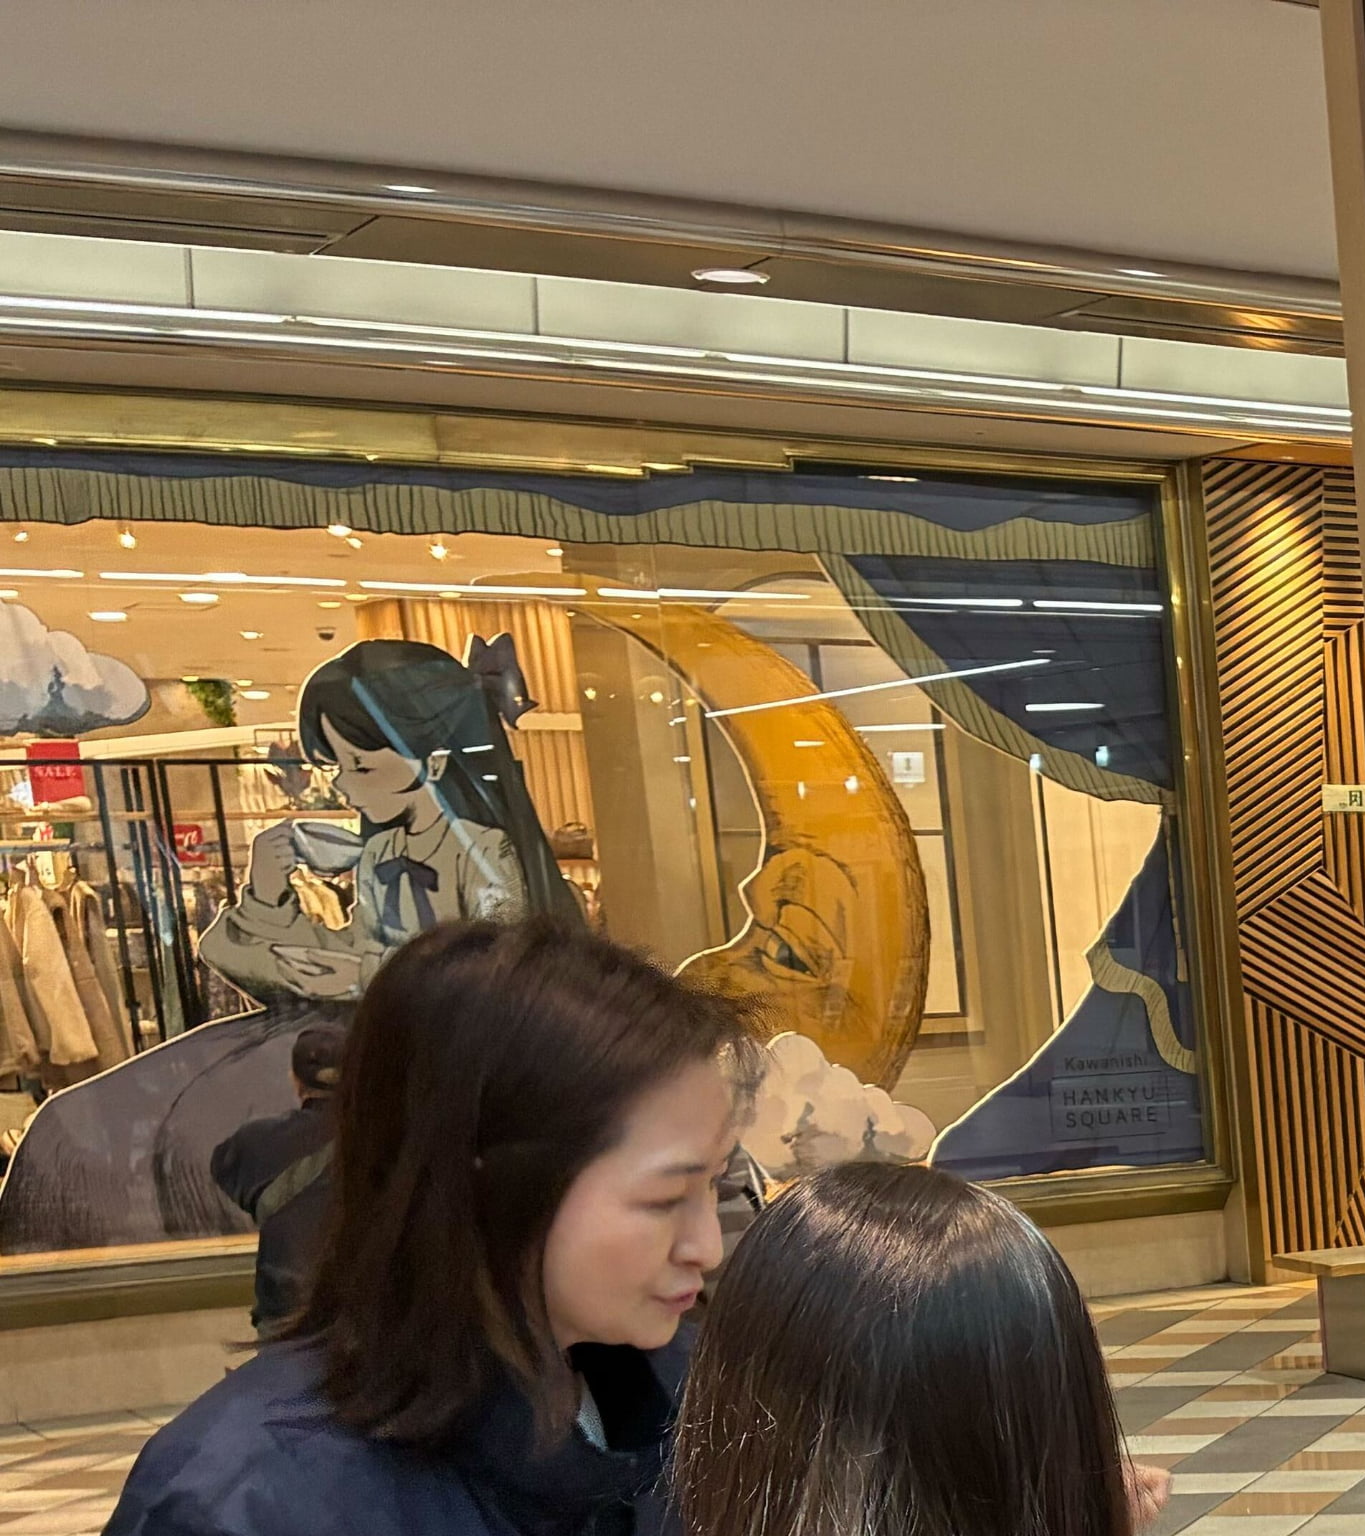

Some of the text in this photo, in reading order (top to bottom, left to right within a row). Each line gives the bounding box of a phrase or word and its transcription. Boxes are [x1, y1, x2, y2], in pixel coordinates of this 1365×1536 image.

[34, 764, 77, 779] SALE
[1064, 1053, 1148, 1071] Kawanishi
[1063, 1085, 1155, 1106] HANKYU
[1066, 1106, 1157, 1129] SQUARE
